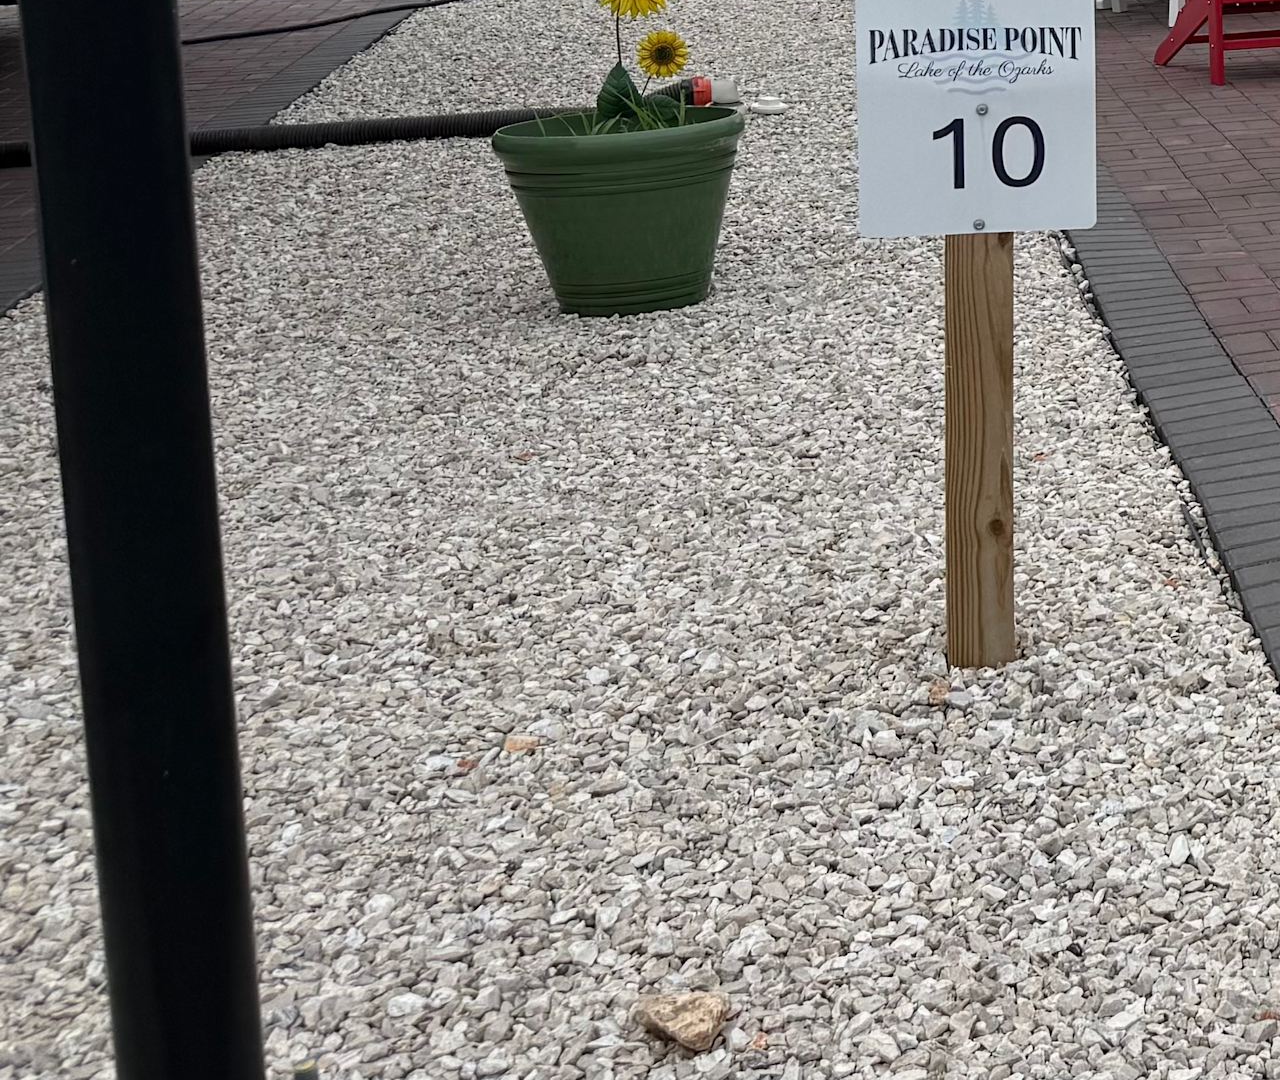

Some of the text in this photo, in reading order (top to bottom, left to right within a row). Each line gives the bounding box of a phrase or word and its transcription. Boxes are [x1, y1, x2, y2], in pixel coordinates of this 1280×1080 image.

[868, 26, 1082, 65] PARADISE POINT
[897, 58, 1055, 83] Lake of the Ozarks
[932, 115, 1046, 190] 10
